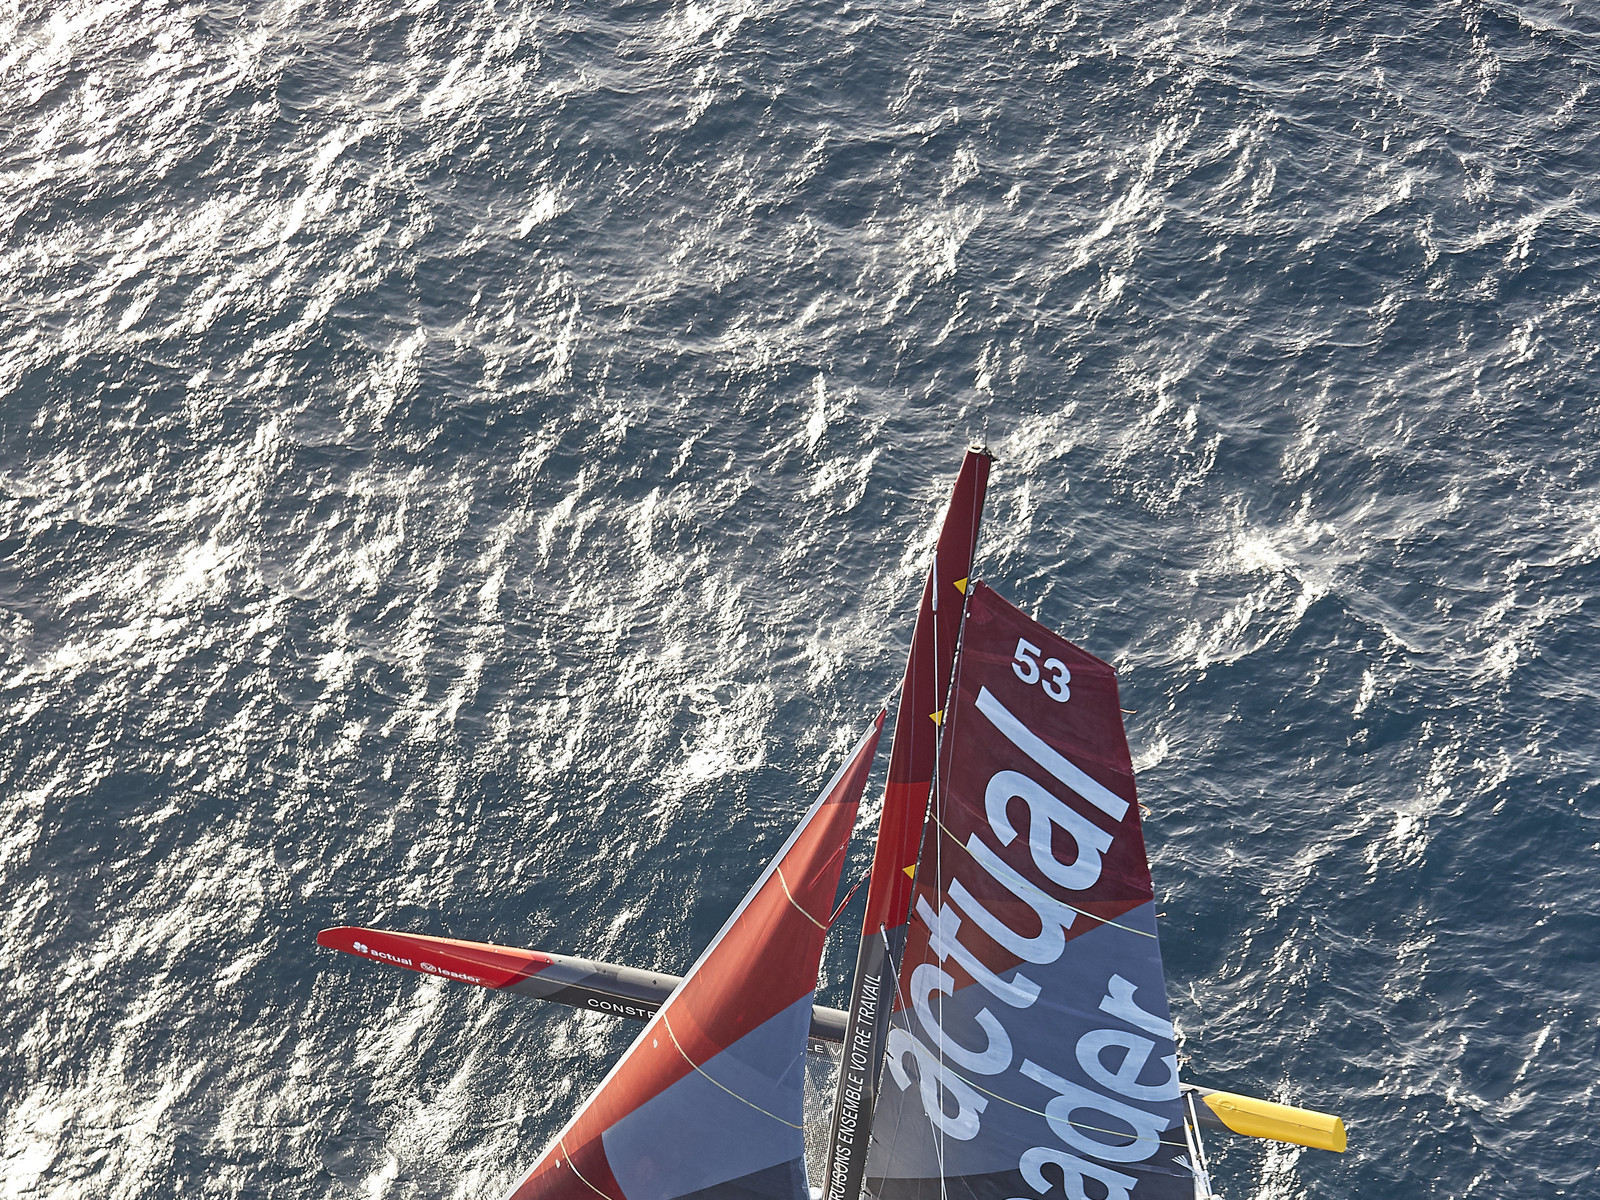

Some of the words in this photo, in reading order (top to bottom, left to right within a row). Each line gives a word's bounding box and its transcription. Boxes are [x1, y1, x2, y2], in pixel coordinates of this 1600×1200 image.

[1011, 637, 1071, 703] 53
[888, 685, 1130, 1141] actual
[370, 948, 413, 967] actual
[437, 965, 481, 984] leader
[858, 974, 881, 1025] TRAVAIL
[850, 1026, 873, 1072] VOTRE
[841, 1073, 863, 1144] ENSEMBLE
